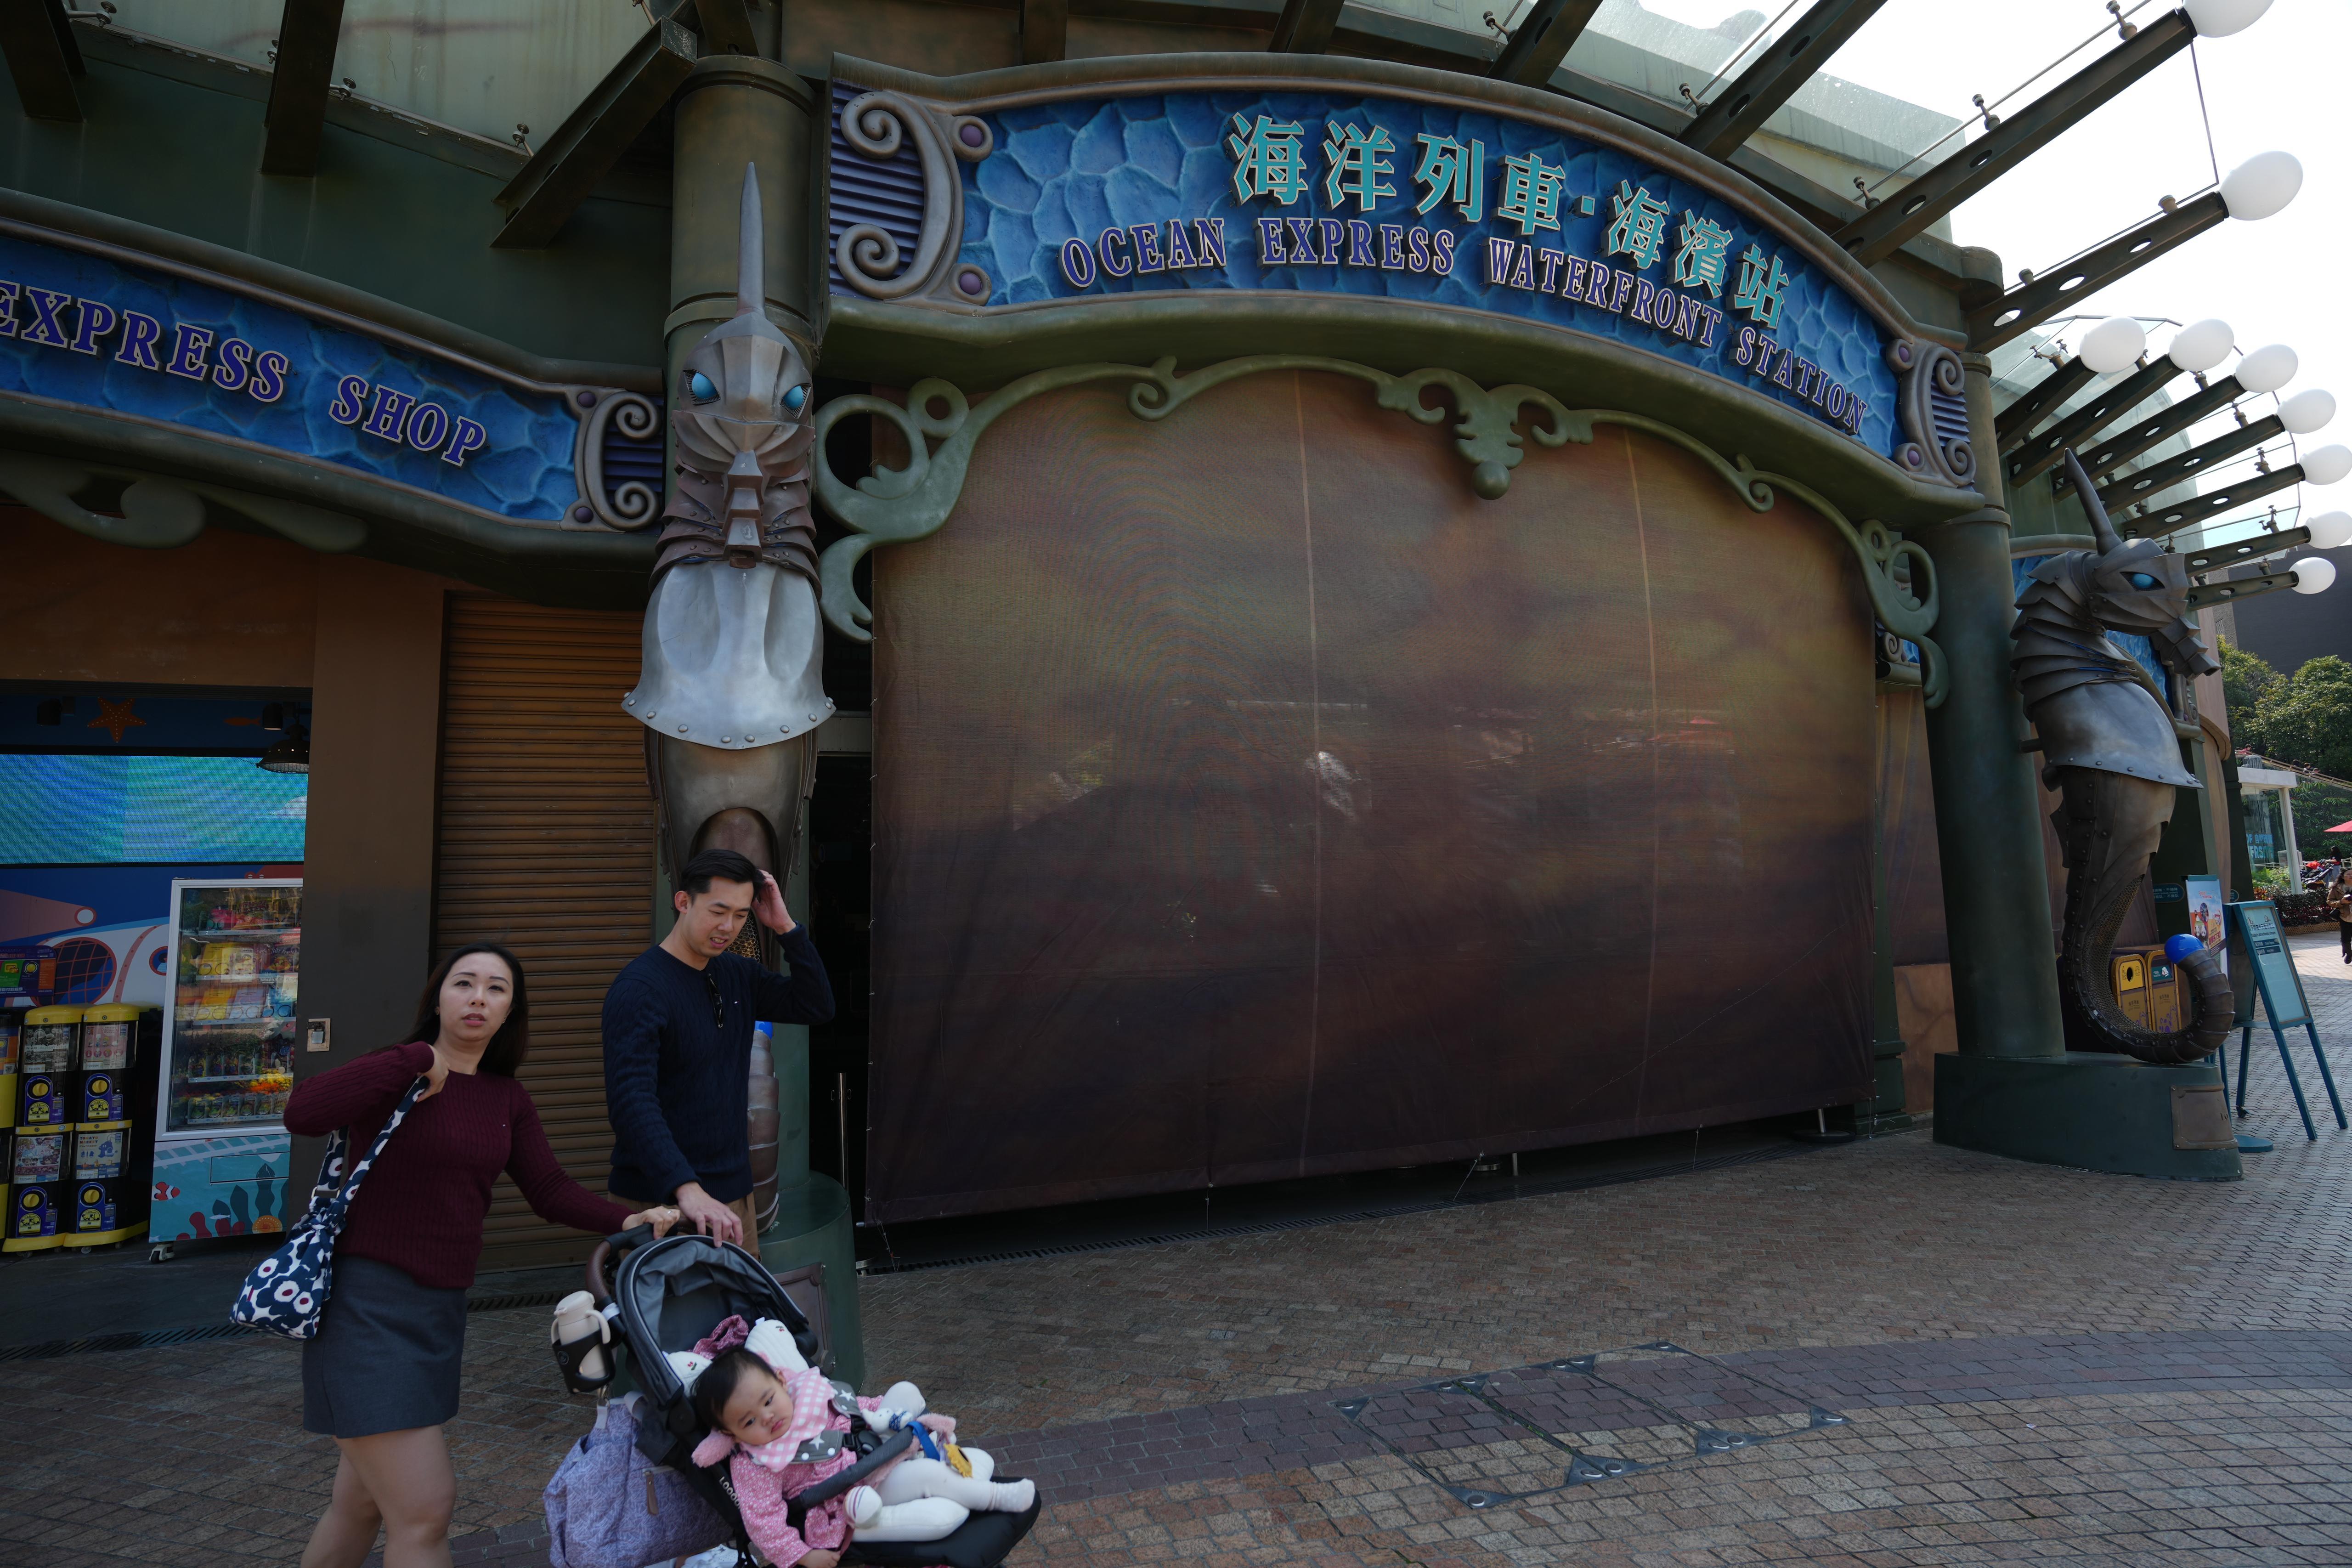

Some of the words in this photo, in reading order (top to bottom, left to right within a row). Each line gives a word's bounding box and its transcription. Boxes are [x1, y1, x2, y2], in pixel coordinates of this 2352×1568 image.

[1227, 112, 1789, 329] 海洋列車·海濱站
[1059, 217, 1227, 289] OCEAN
[1257, 217, 1454, 276] EXPRESS
[1487, 237, 1722, 348] WATERFRONT
[1736, 326, 1868, 435] STATION
[328, 374, 487, 467] SHOP
[718, 1476, 741, 1510] LOOOO
